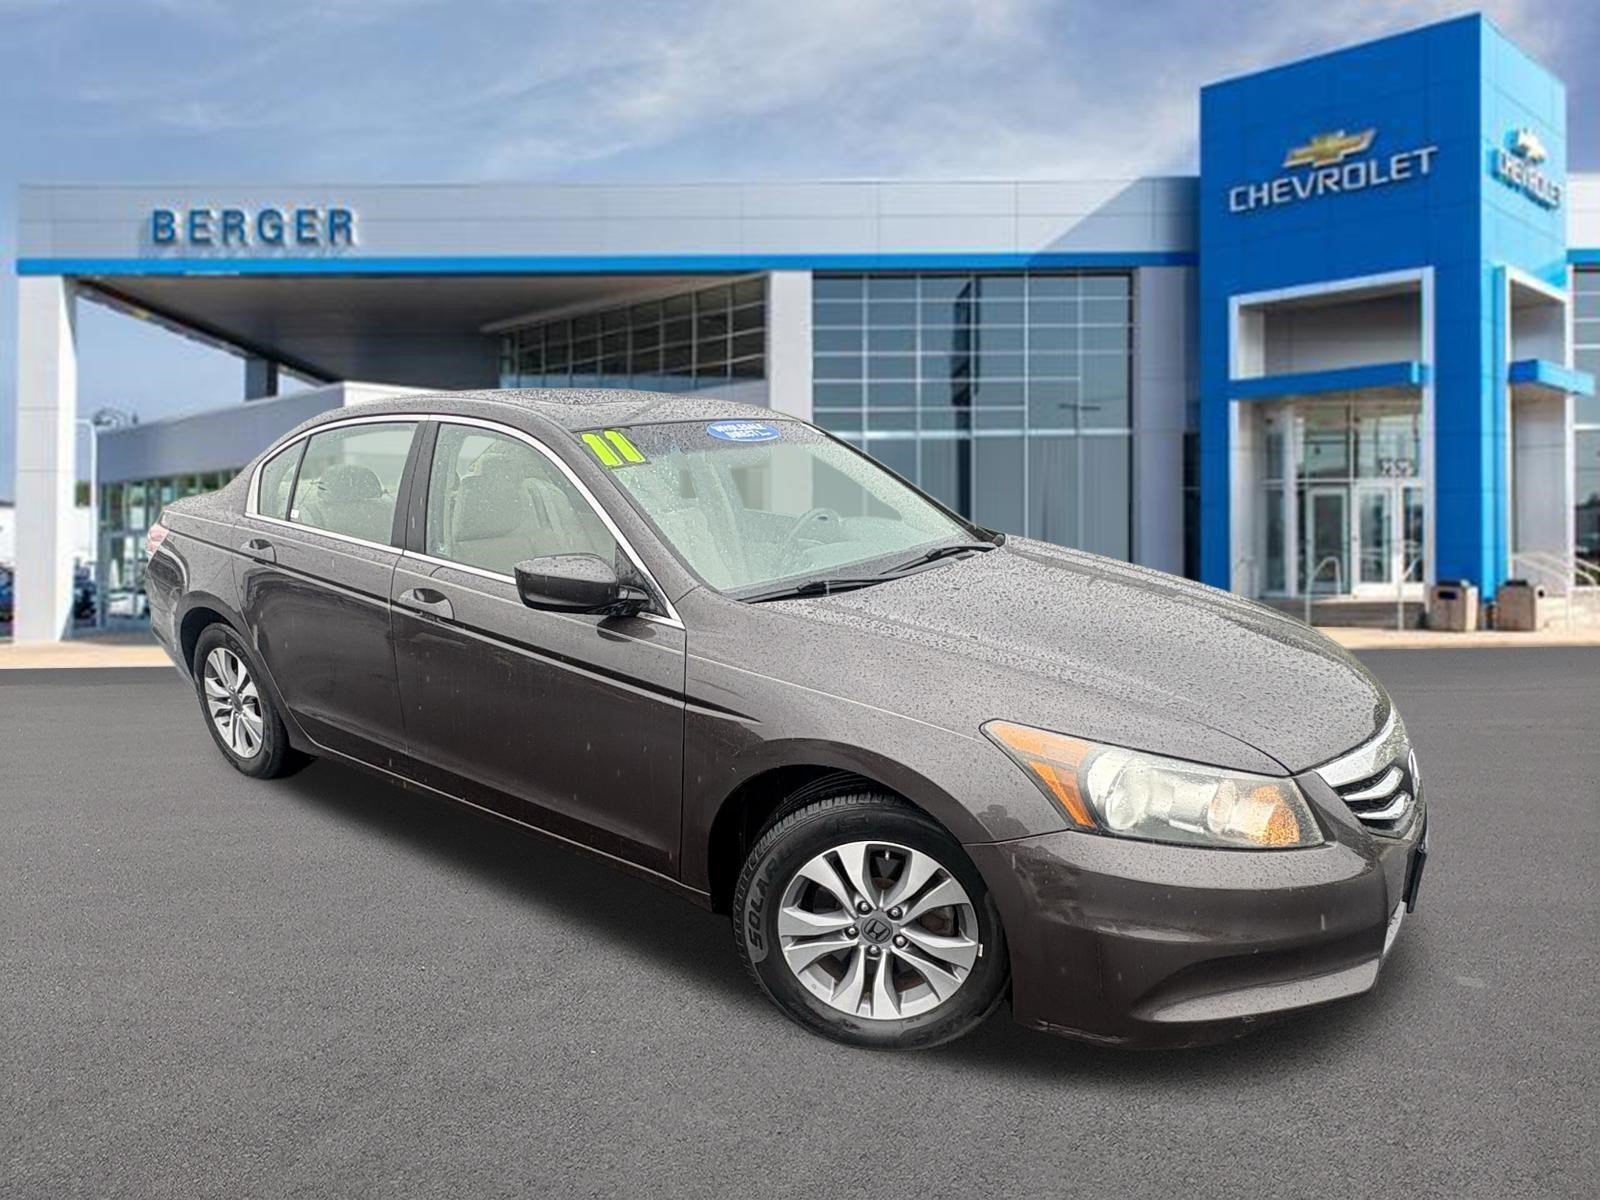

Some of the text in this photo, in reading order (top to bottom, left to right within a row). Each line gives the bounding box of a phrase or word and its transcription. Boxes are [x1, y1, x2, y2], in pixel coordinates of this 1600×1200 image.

[1229, 146, 1437, 213] CHEVROLET
[152, 208, 355, 245] BERGER
[581, 430, 646, 467] 11
